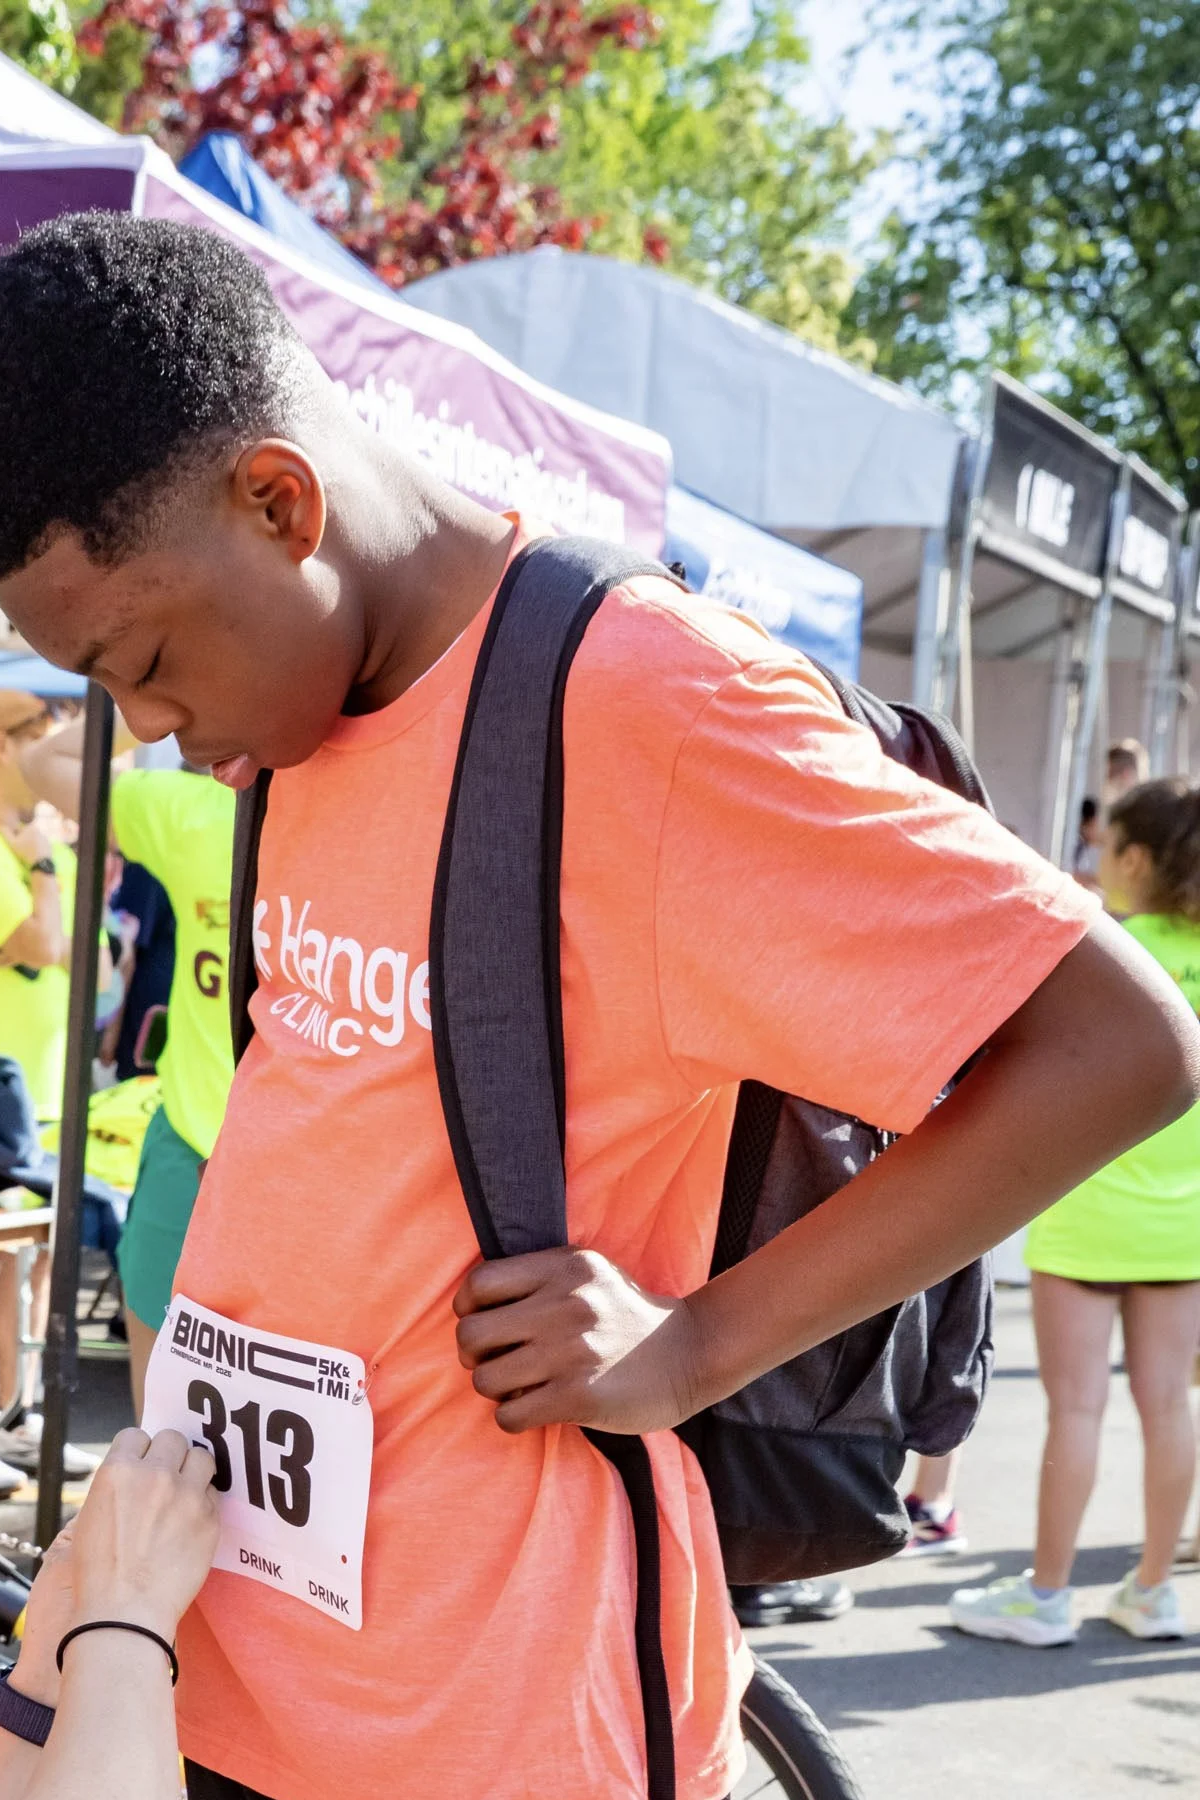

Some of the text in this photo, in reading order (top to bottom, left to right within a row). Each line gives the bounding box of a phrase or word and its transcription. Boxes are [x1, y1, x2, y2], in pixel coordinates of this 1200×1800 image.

[172, 1309, 317, 1392] BIONIC
[187, 1379, 315, 1528] 313
[239, 1548, 284, 1581] DRINK
[308, 1579, 350, 1615] DRINK
